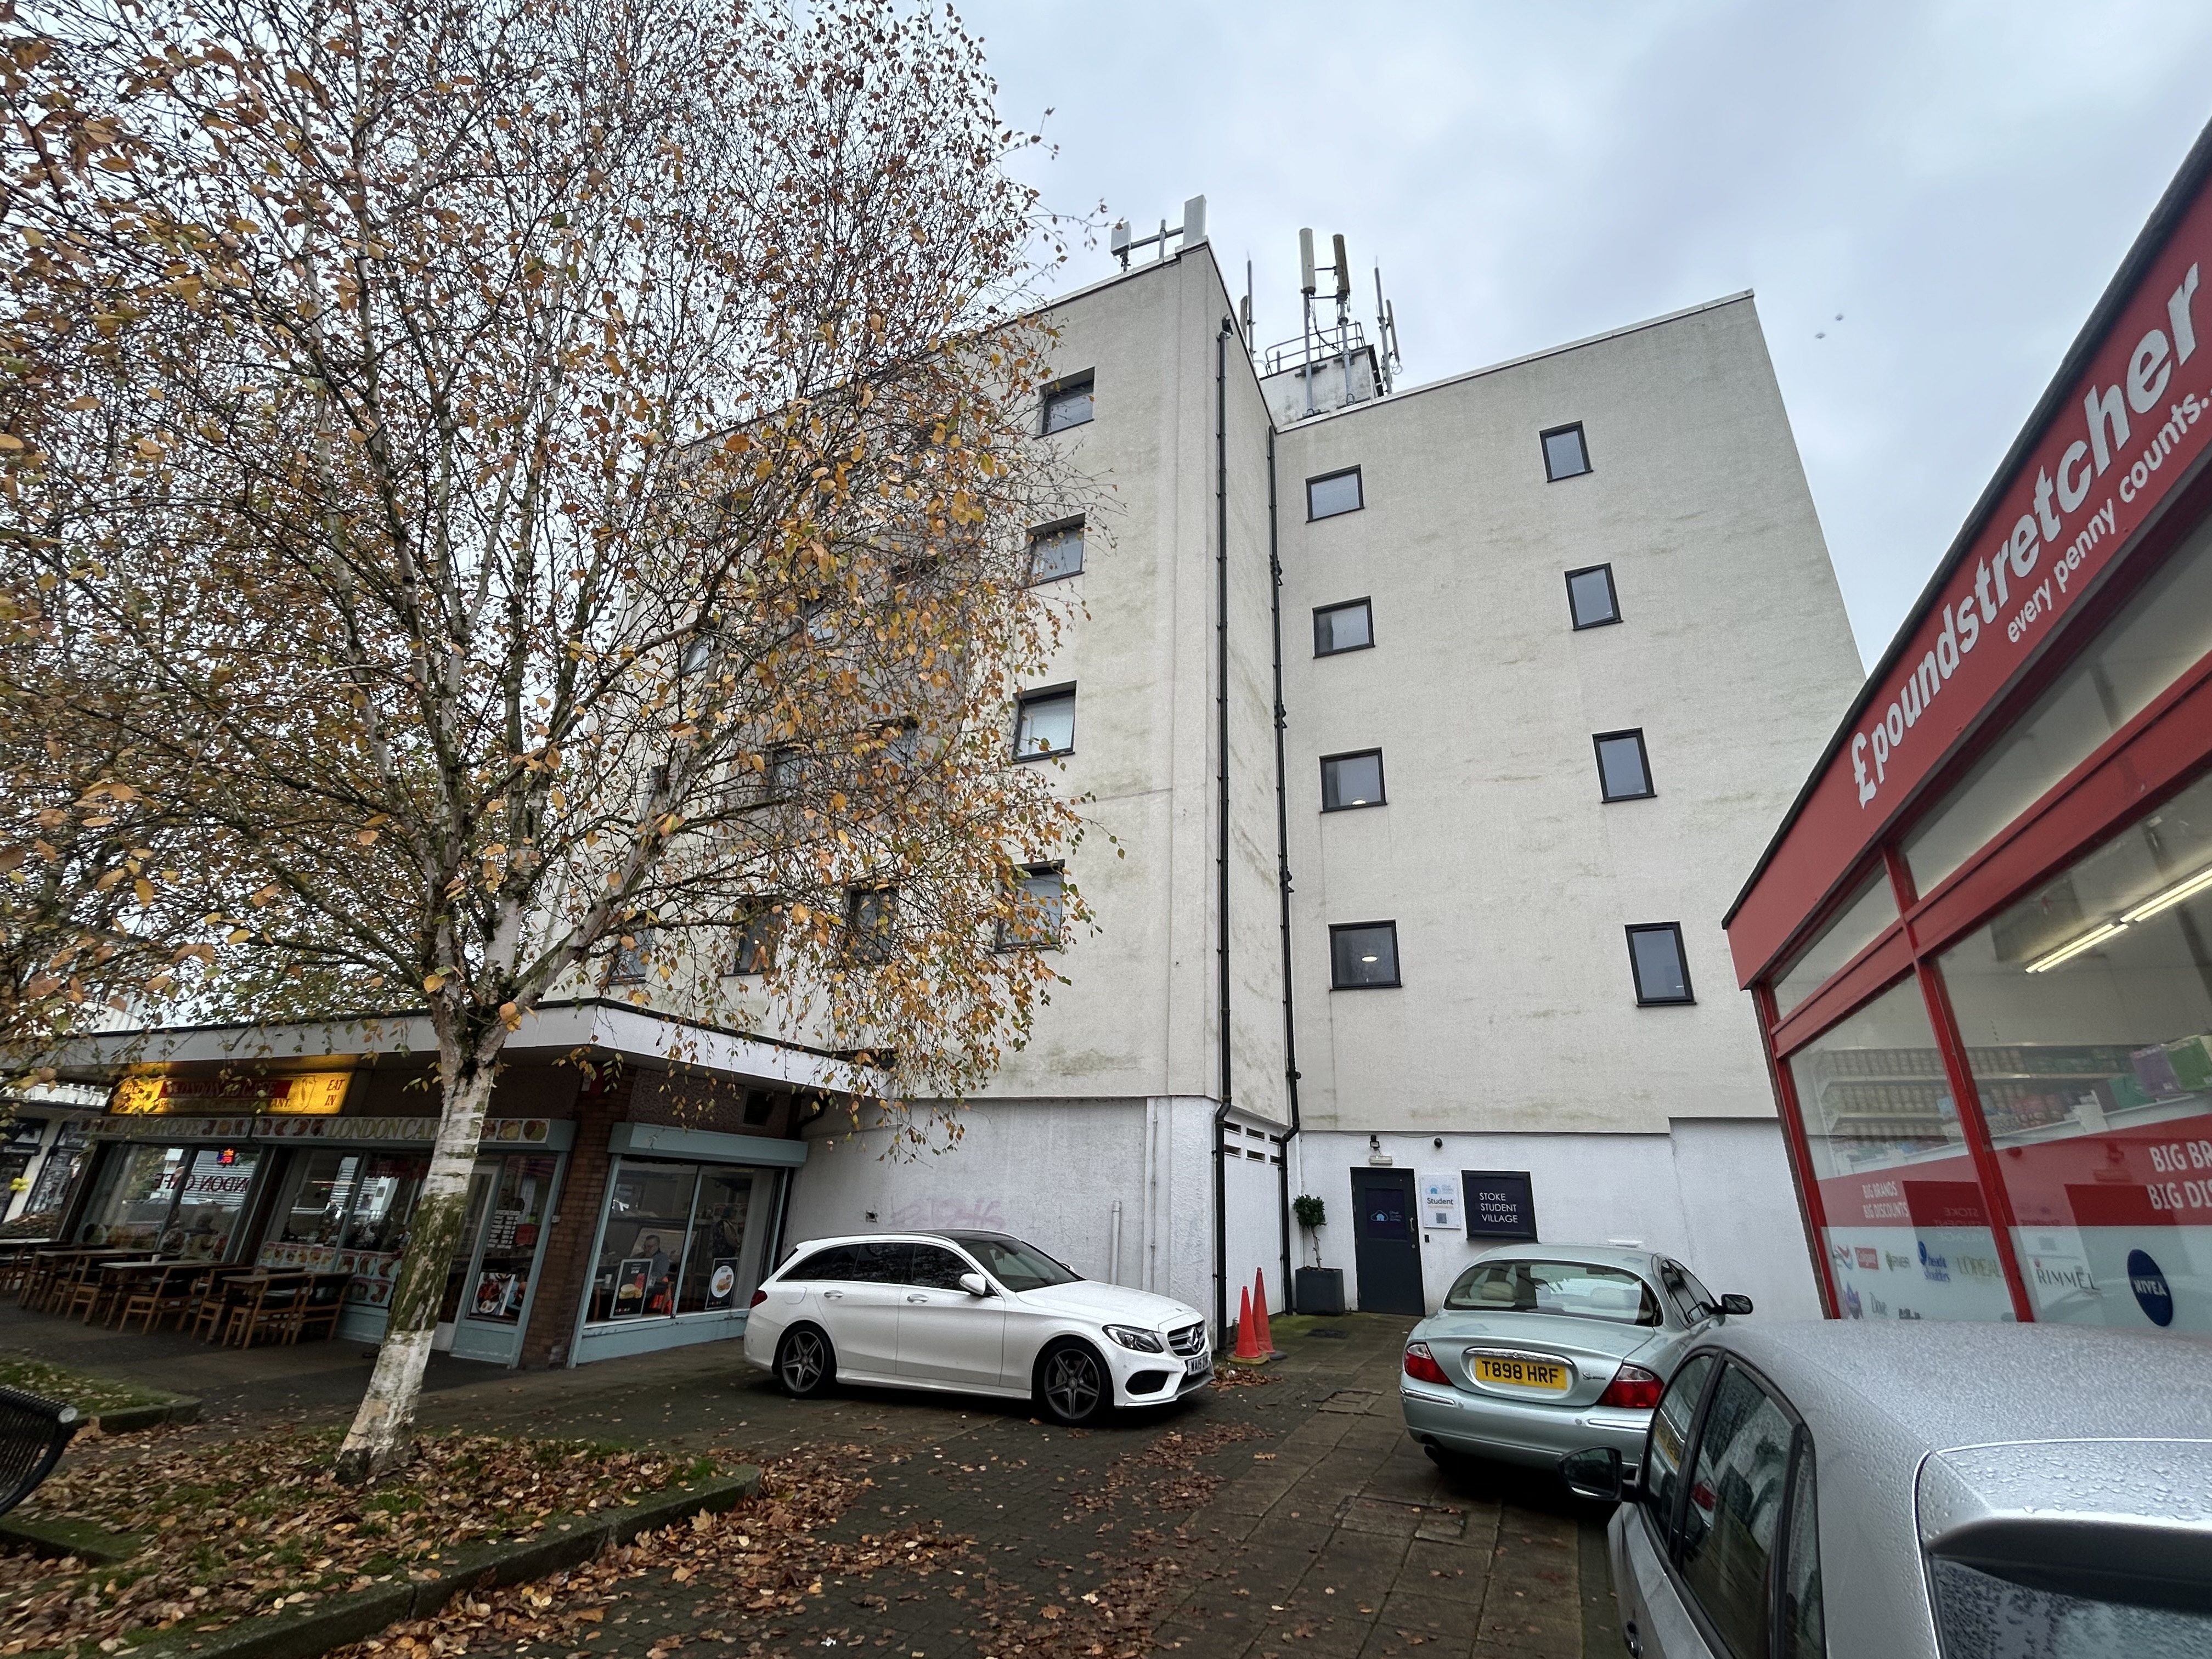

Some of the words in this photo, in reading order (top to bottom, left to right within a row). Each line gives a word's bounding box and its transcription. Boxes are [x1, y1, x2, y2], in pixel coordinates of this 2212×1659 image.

[2007, 578, 2052, 643] every
[2053, 499, 2115, 593] penny
[326, 1079, 345, 1091] EAT
[324, 1094, 337, 1106] IN
[326, 1118, 402, 1139] LONDON
[401, 1119, 439, 1140] CAF
[2148, 1143, 2187, 1172] BIG
[1479, 1192, 1506, 1201] STOKE
[1862, 1183, 1874, 1199] BIG
[1872, 1181, 1898, 1198] BRANDS
[2146, 1182, 2184, 1210] BIG
[1426, 1197, 1454, 1205] Student
[1480, 1203, 1517, 1212] STUDENT
[1863, 1203, 1875, 1218] BIG
[1873, 1201, 1909, 1218] DISCOUNTS
[1481, 1214, 1519, 1223] VILLAGE
[2036, 1268, 2101, 1290] RIMMEL
[2133, 1279, 2168, 1297] NIVEA
[1482, 1361, 1522, 1380] T898
[1527, 1364, 1559, 1384] HRF
